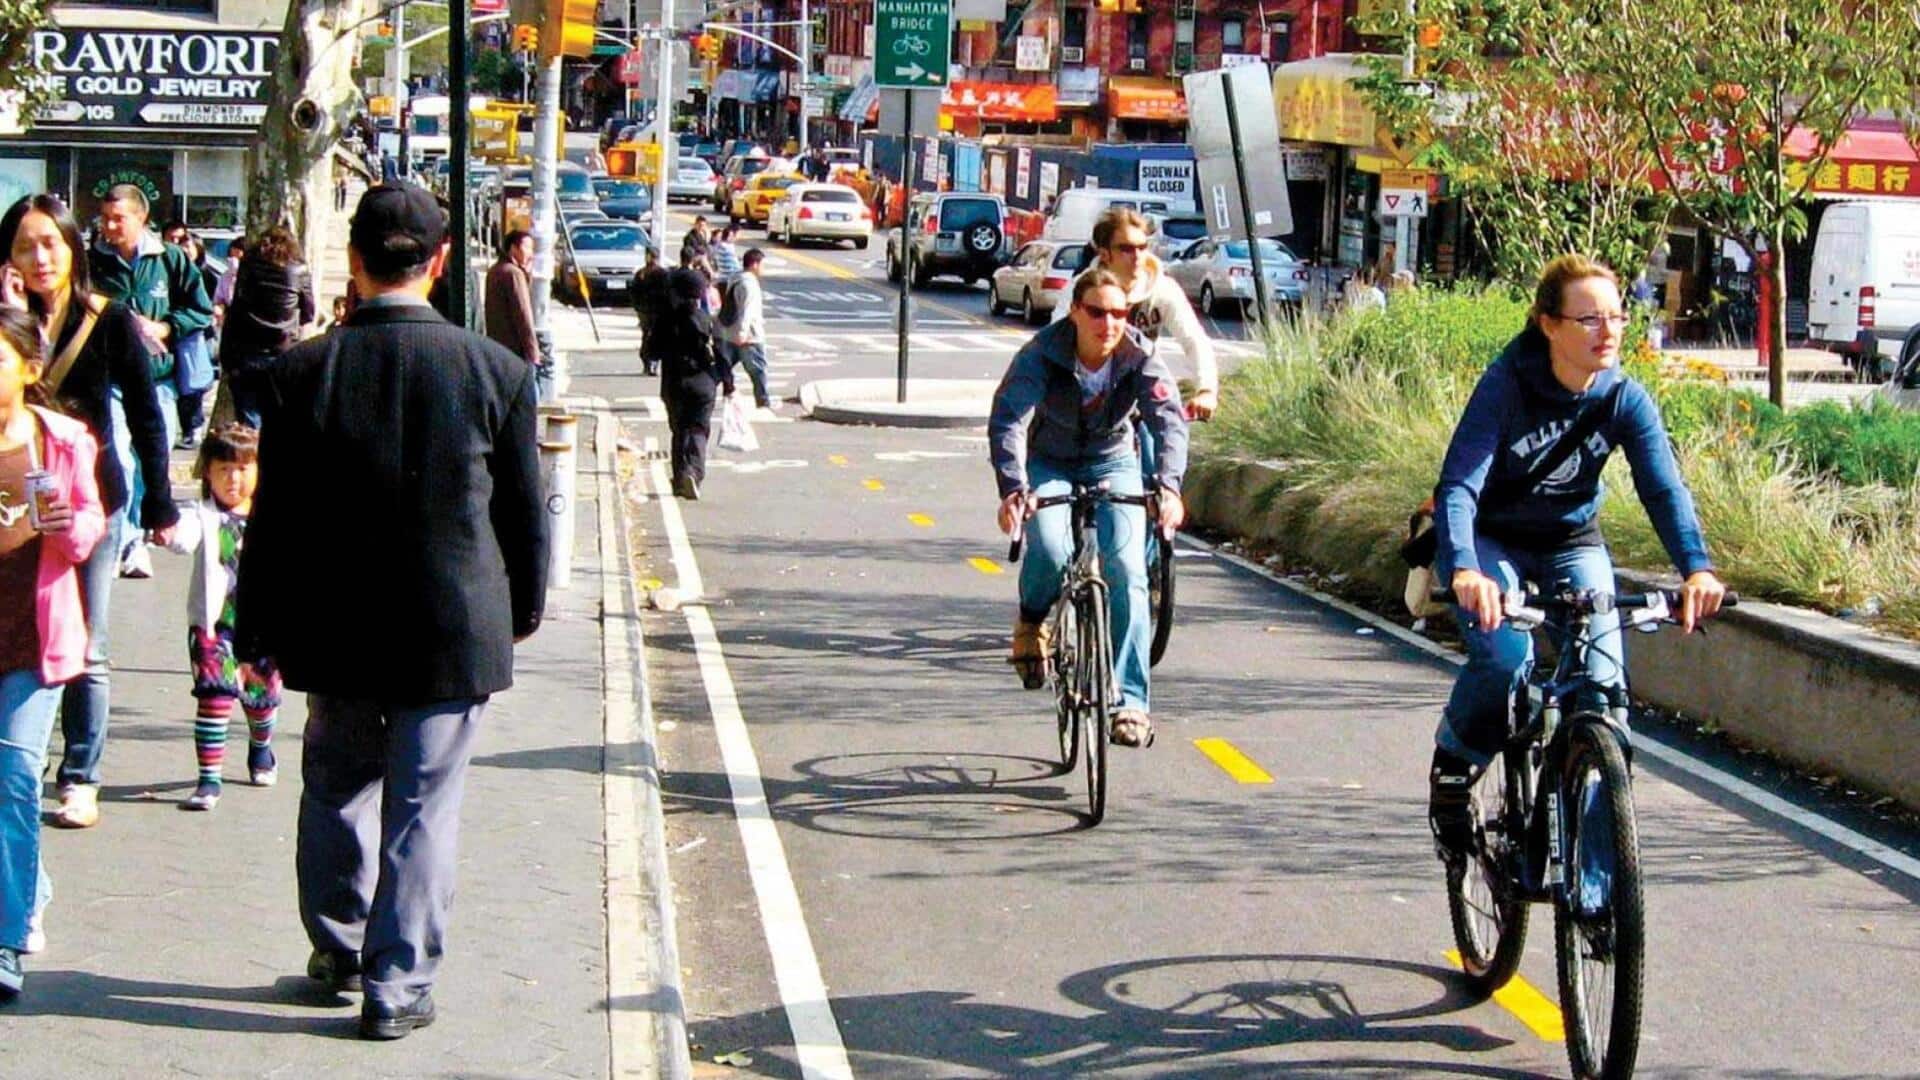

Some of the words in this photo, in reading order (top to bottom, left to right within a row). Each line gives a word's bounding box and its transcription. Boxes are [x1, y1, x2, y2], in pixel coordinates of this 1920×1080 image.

[878, 2, 948, 15] MANHATTAN
[890, 16, 935, 31] BRIDGE
[76, 76, 143, 95] GOLD
[150, 79, 262, 97] JEWELRY
[87, 104, 115, 120] 105
[184, 105, 243, 113] DIAMONDS
[161, 113, 217, 123] PRECIOUS
[1142, 166, 1191, 178] SIDEWALK
[1148, 180, 1185, 192] CLOSED
